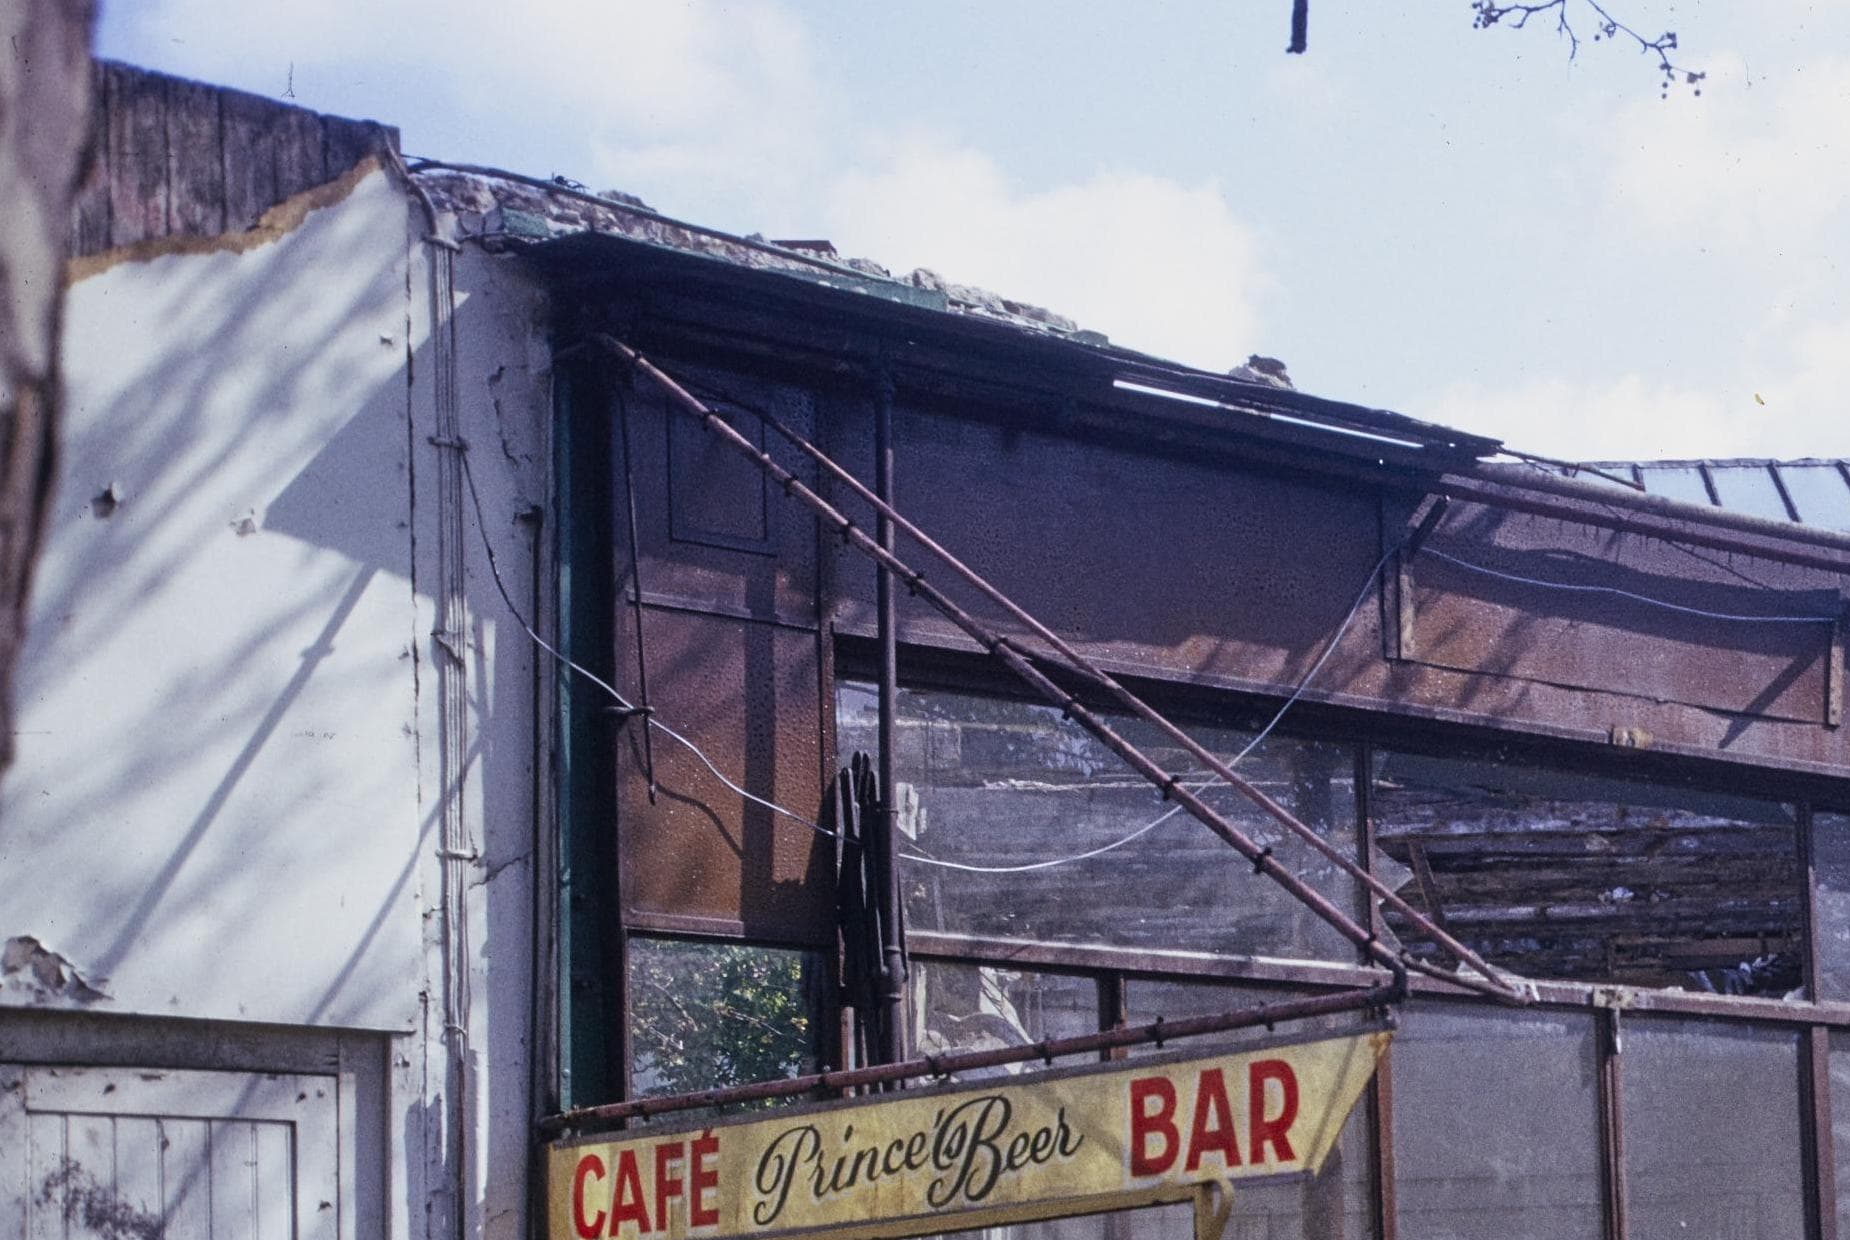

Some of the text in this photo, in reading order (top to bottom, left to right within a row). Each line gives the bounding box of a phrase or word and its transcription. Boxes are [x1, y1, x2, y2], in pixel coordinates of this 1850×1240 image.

[573, 1128, 721, 1240] CAFÉ
[927, 1093, 1084, 1208] Beer
[1129, 1059, 1300, 1180] BAR
